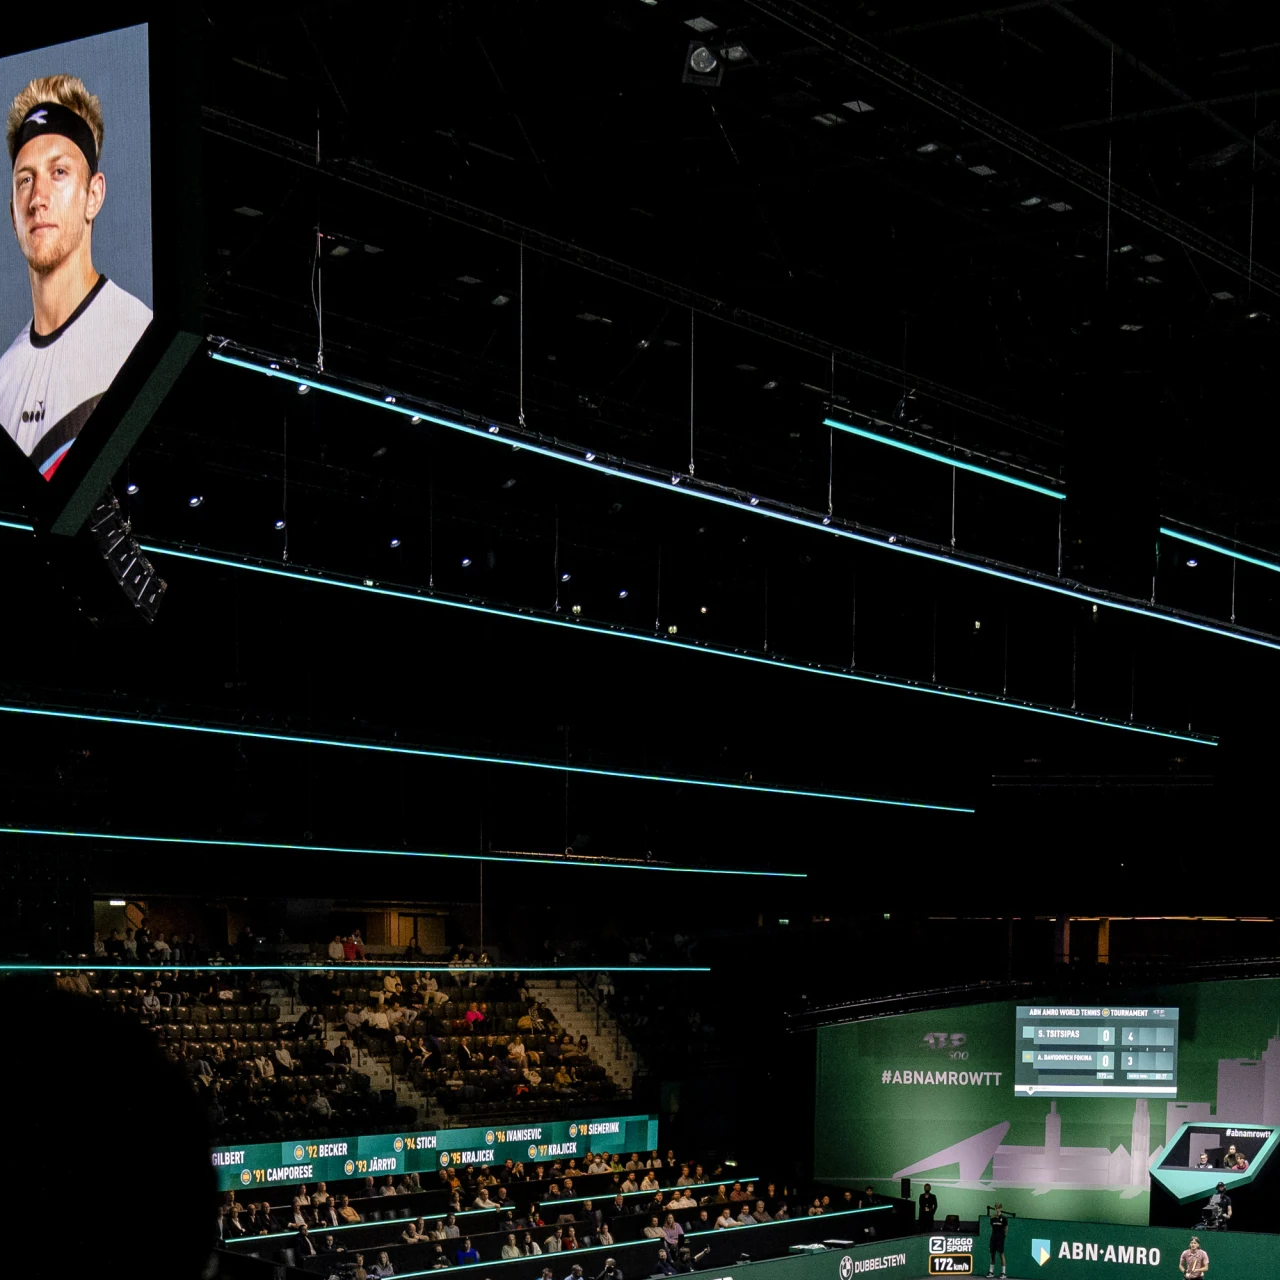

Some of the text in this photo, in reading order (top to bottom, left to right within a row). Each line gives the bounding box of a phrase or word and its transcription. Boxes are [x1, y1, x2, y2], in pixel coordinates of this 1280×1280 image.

[1081, 1009, 1101, 1017] TENNIS
[1110, 1009, 1148, 1017] TOURNAMENT
[1038, 1030, 1109, 1042] S. TSITSIPAS 0
[1128, 1033, 1134, 1041] 4
[1102, 1055, 1109, 1067] 0
[1127, 1056, 1133, 1066] 3
[881, 1070, 1002, 1086] #ABNAMROWTT
[495, 1128, 541, 1142] '96 IVANISEVIC
[579, 1122, 619, 1135] '98 SIEMERINK
[405, 1136, 436, 1149] '94 STICH
[538, 1142, 577, 1156] '97 KRAJICEK
[306, 1143, 347, 1158] '92 BECKER
[451, 1150, 494, 1164] '95 KRAJICEK
[212, 1151, 245, 1166] GILBERT
[355, 1157, 396, 1172] '93 JÄRRYD
[253, 1165, 312, 1182] '91 CAMPORESE
[855, 1253, 906, 1273] DUBBELSTEYN
[934, 1258, 969, 1271] 172 km/h
